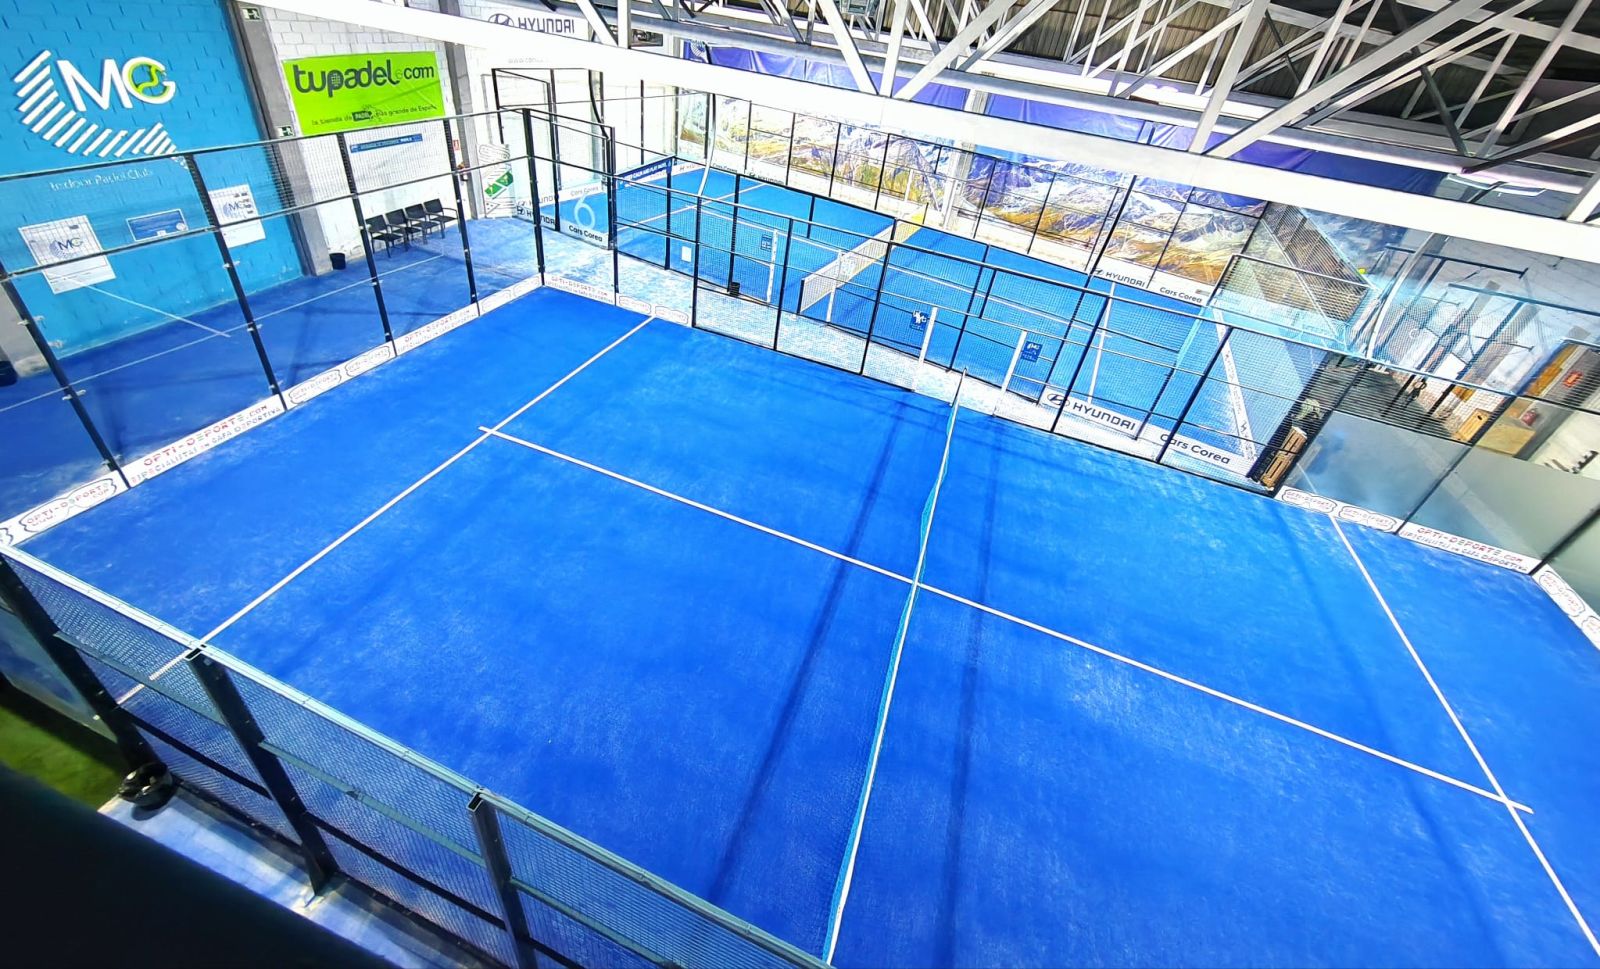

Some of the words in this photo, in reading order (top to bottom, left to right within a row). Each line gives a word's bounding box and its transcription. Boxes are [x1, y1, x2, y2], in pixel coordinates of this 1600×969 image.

[518, 17, 575, 34] HYUNDAI
[574, 194, 596, 229] 6
[568, 224, 583, 236] Cars
[583, 230, 603, 243] Corea
[1105, 271, 1146, 288] HYUNDAI
[1159, 286, 1178, 297] Cars
[1178, 292, 1203, 304] Corea
[1072, 401, 1137, 431] HYUNDAI
[1190, 443, 1231, 465] Corea
